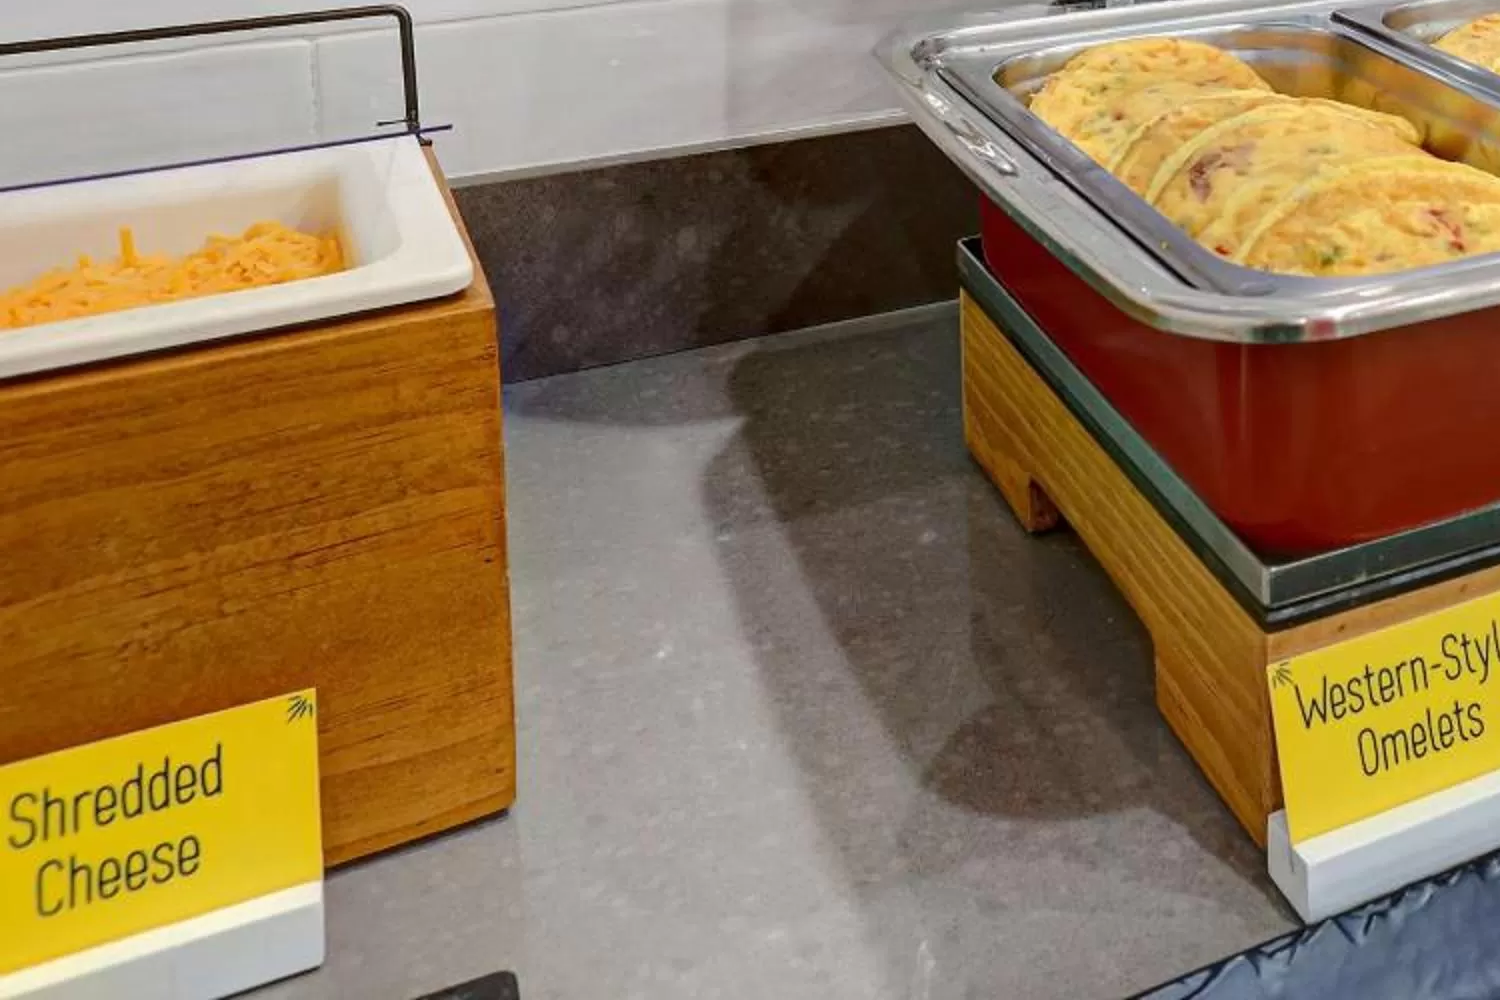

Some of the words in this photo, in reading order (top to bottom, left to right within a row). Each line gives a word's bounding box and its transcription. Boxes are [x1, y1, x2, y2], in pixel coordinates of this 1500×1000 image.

[1356, 700, 1485, 777] Omelets
[7, 740, 224, 850] Shredded
[35, 833, 201, 918] Cheese
